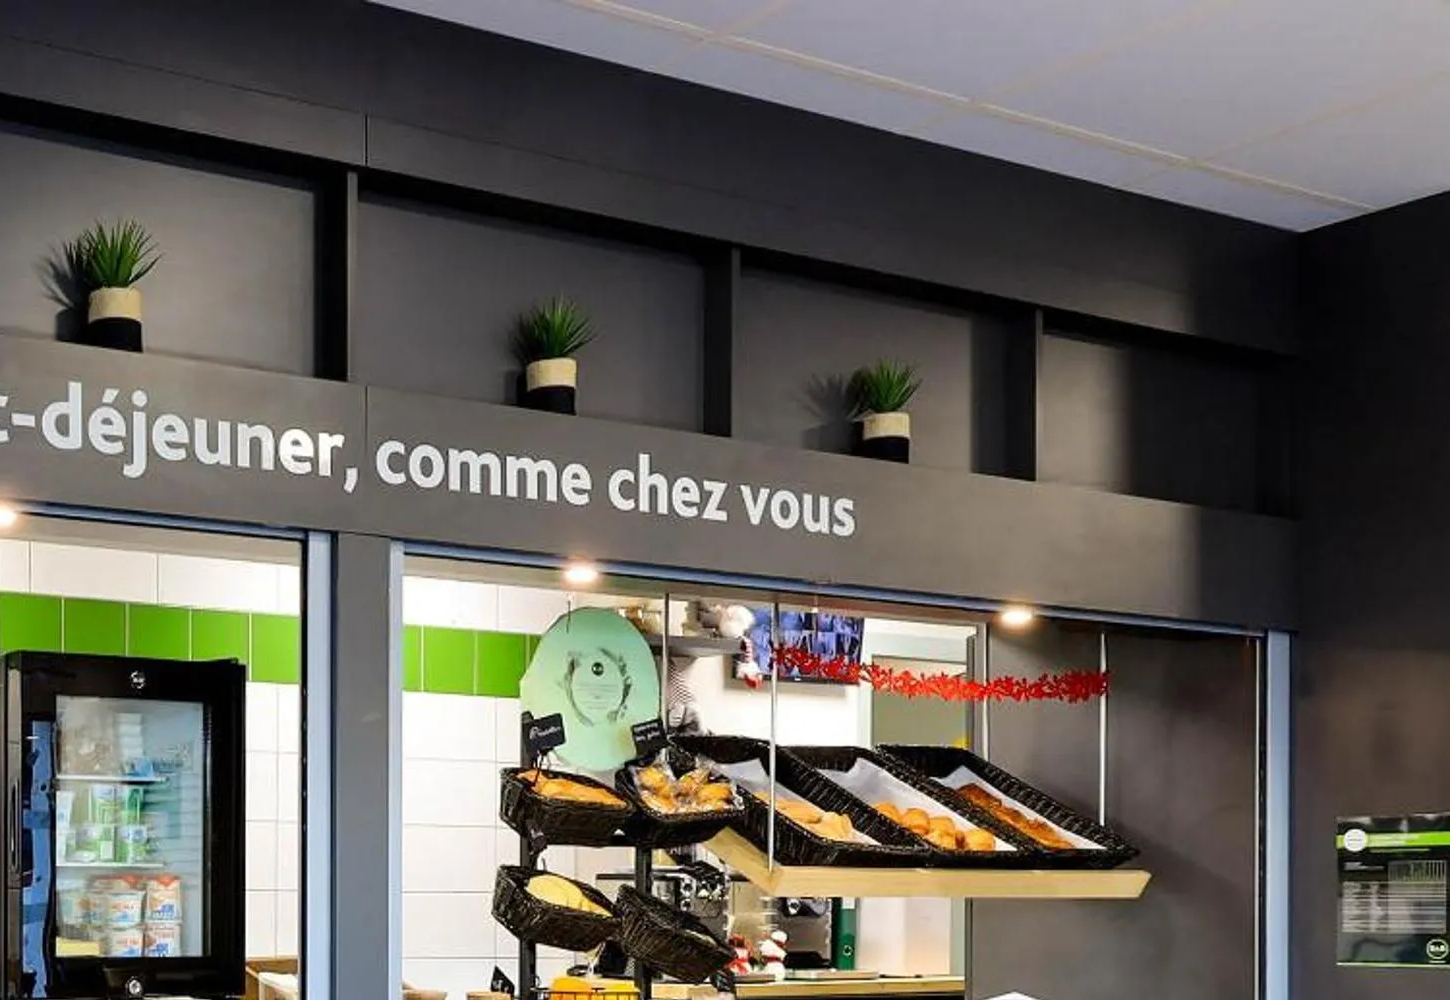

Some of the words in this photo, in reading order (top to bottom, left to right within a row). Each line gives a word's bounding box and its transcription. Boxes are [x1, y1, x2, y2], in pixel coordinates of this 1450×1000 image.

[375, 440, 593, 506] comme
[607, 453, 729, 522] chez
[738, 484, 857, 537] vous
